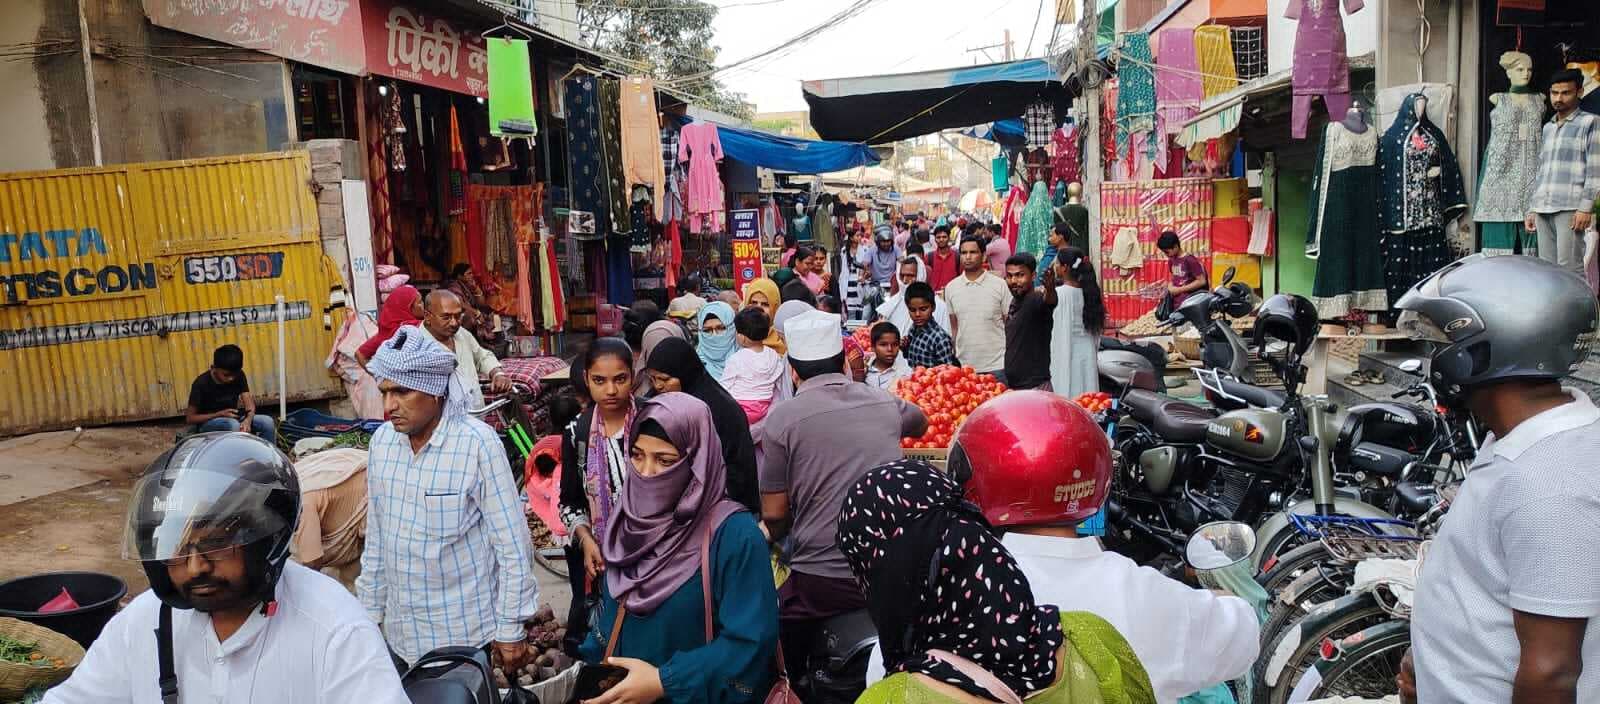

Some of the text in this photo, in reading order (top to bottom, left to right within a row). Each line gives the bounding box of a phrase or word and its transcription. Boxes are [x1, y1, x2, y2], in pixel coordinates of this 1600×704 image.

[385, 7, 461, 79] पिंकी
[0, 228, 108, 262] TATA
[735, 242, 759, 258] 50%
[0, 263, 157, 304] TISCON
[104, 318, 159, 337] TISCON
[210, 311, 235, 327] 550
[241, 308, 259, 323] SD
[1054, 479, 1096, 503] STUDDS
